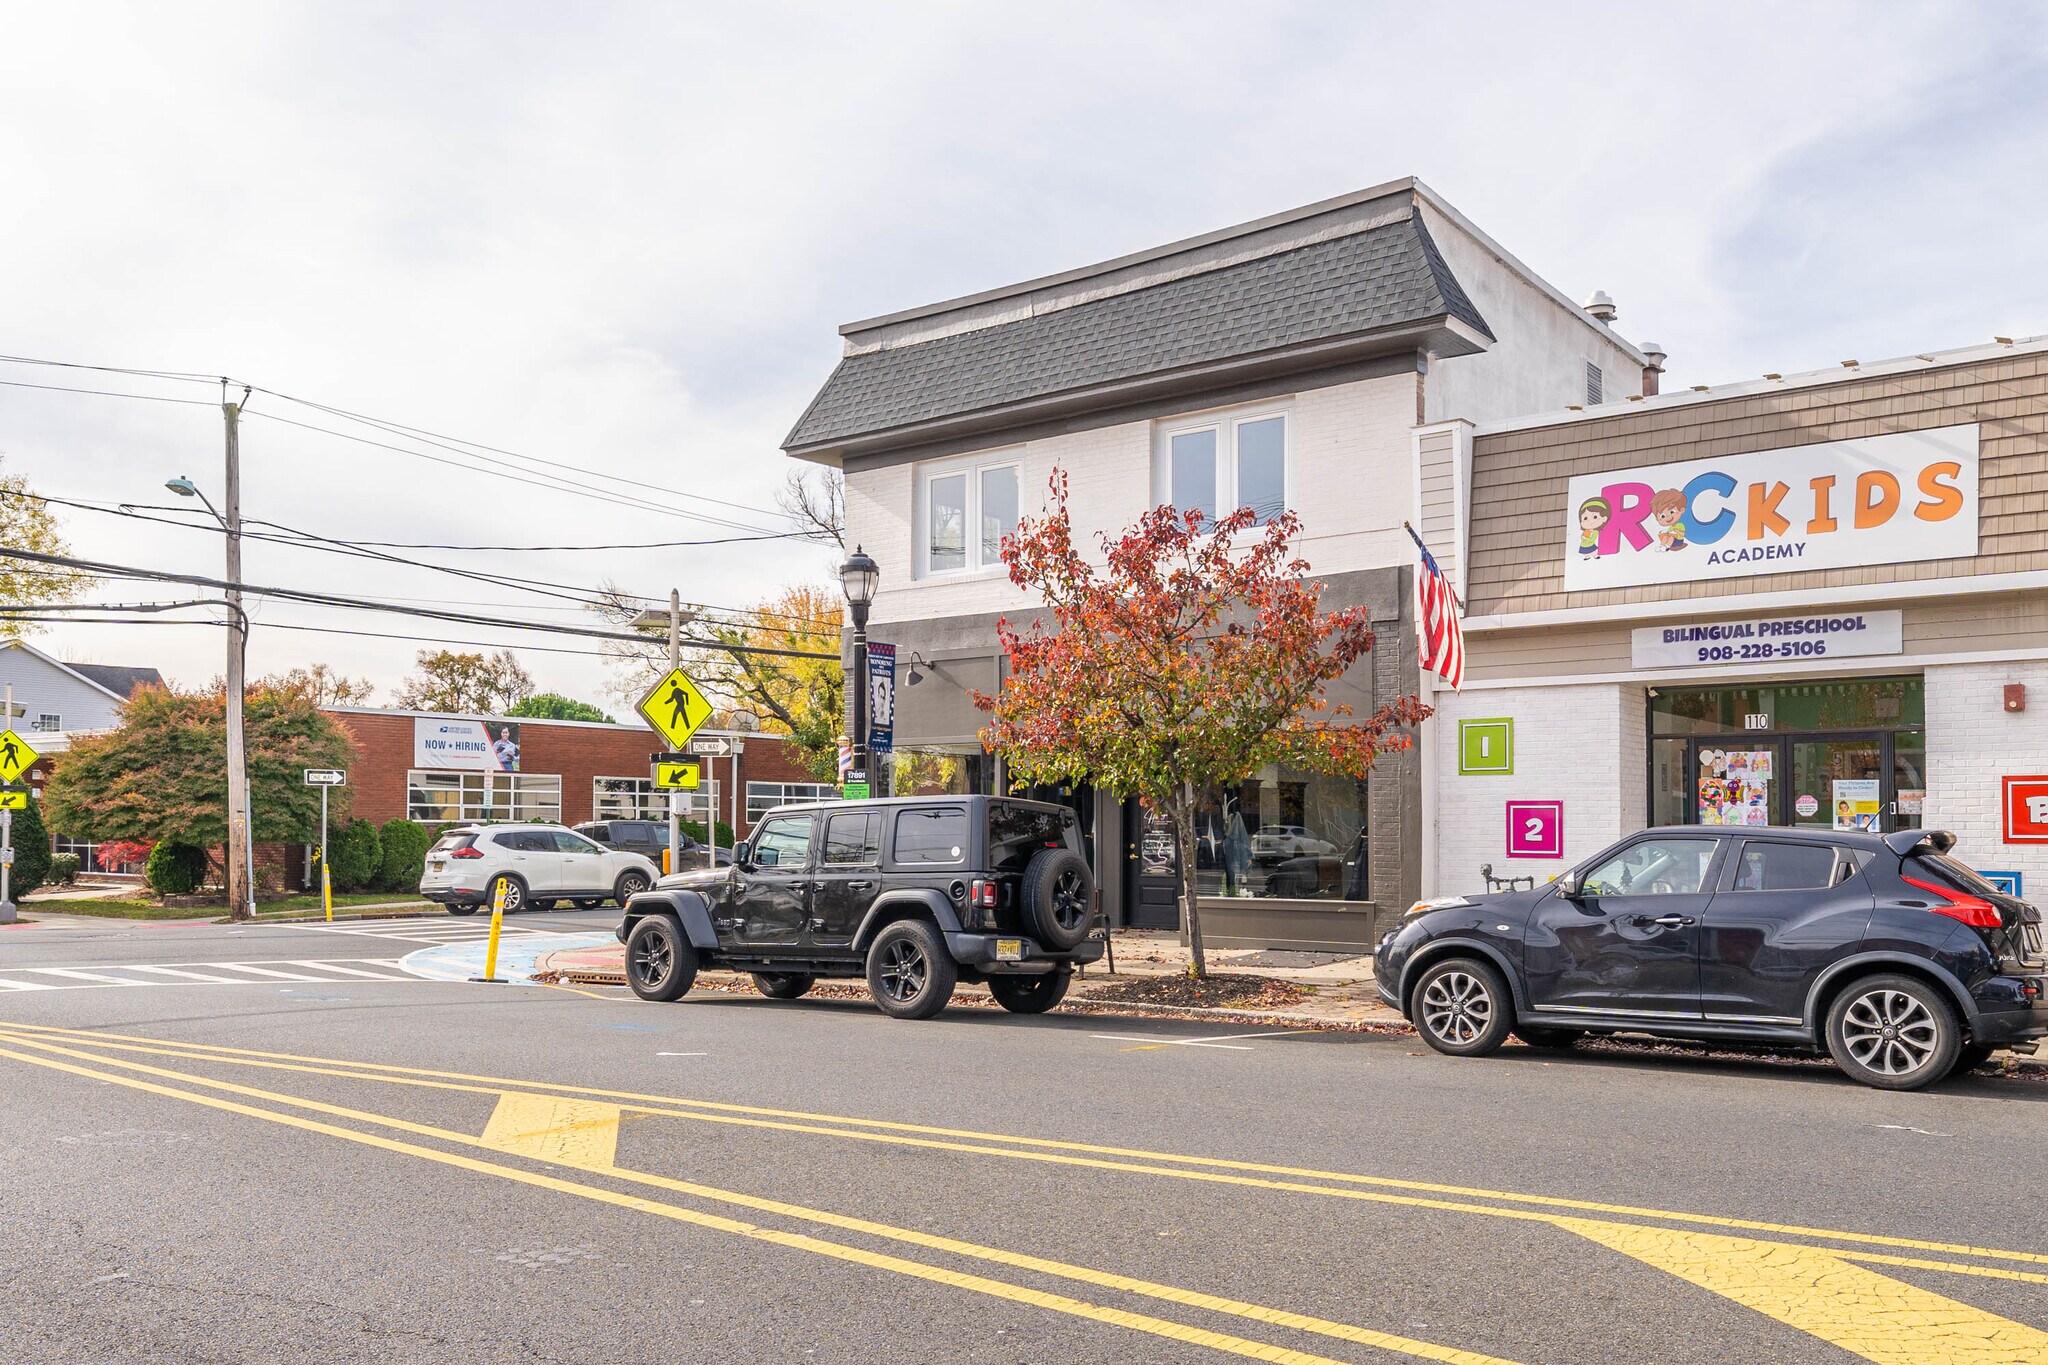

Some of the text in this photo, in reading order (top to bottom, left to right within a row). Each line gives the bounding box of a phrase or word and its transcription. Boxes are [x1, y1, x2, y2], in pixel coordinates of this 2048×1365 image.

[1707, 543, 1806, 566] ACADEMY
[1662, 616, 1867, 643] BILINGUAL PRESCHOOL
[1698, 640, 1826, 662] 908-228-5106
[1747, 714, 1768, 729] 110
[425, 739, 486, 752] NOW HIRING
[694, 743, 720, 751] ONE WAY
[1524, 817, 1544, 842] 2
